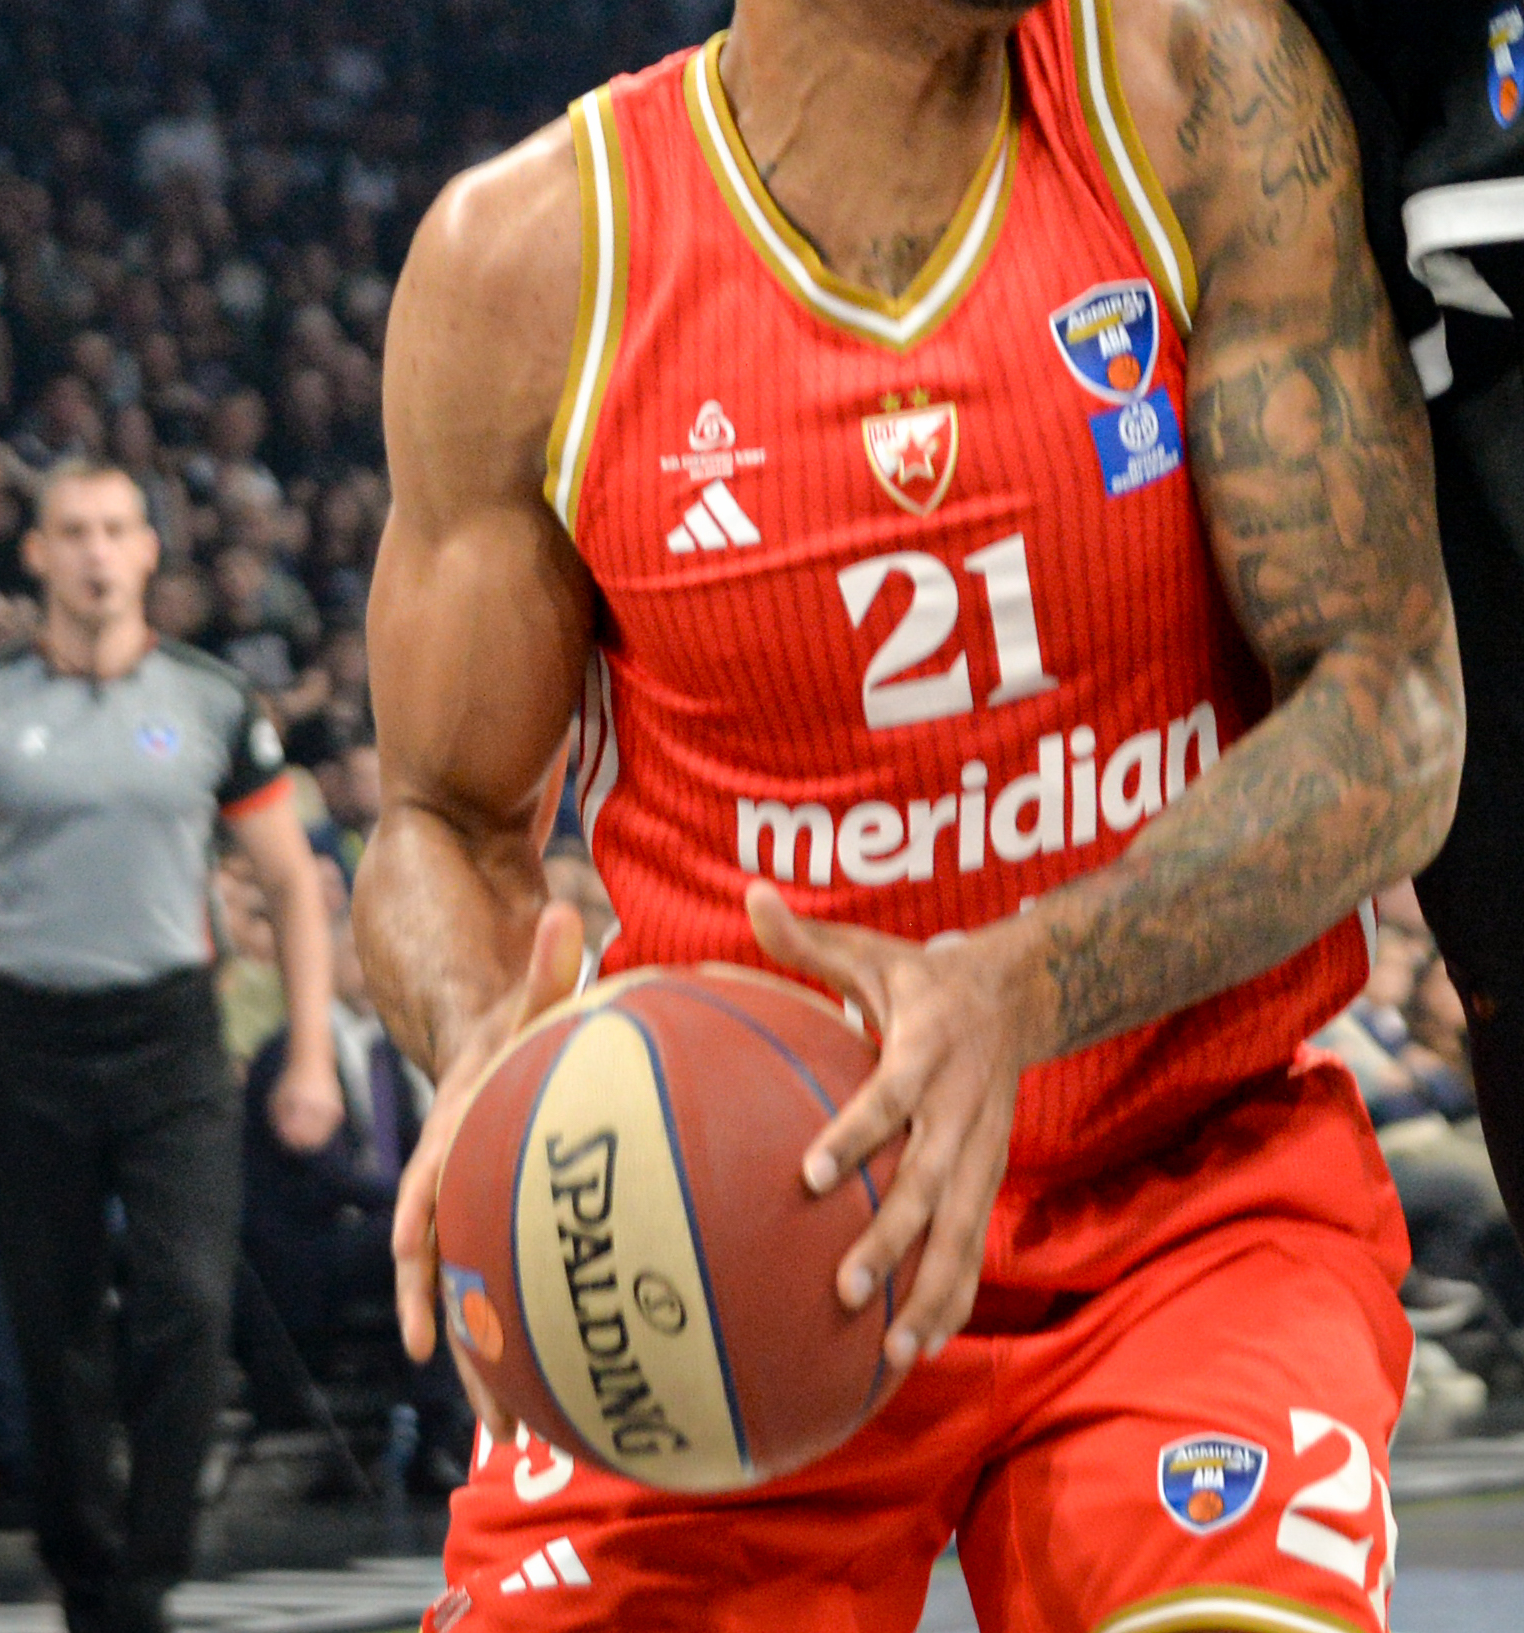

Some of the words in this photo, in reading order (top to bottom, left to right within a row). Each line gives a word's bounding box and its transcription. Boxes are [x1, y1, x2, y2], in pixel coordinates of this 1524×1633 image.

[837, 532, 1060, 730] 21
[736, 699, 1220, 886] meridian
[545, 1125, 689, 1459] SPALDING
